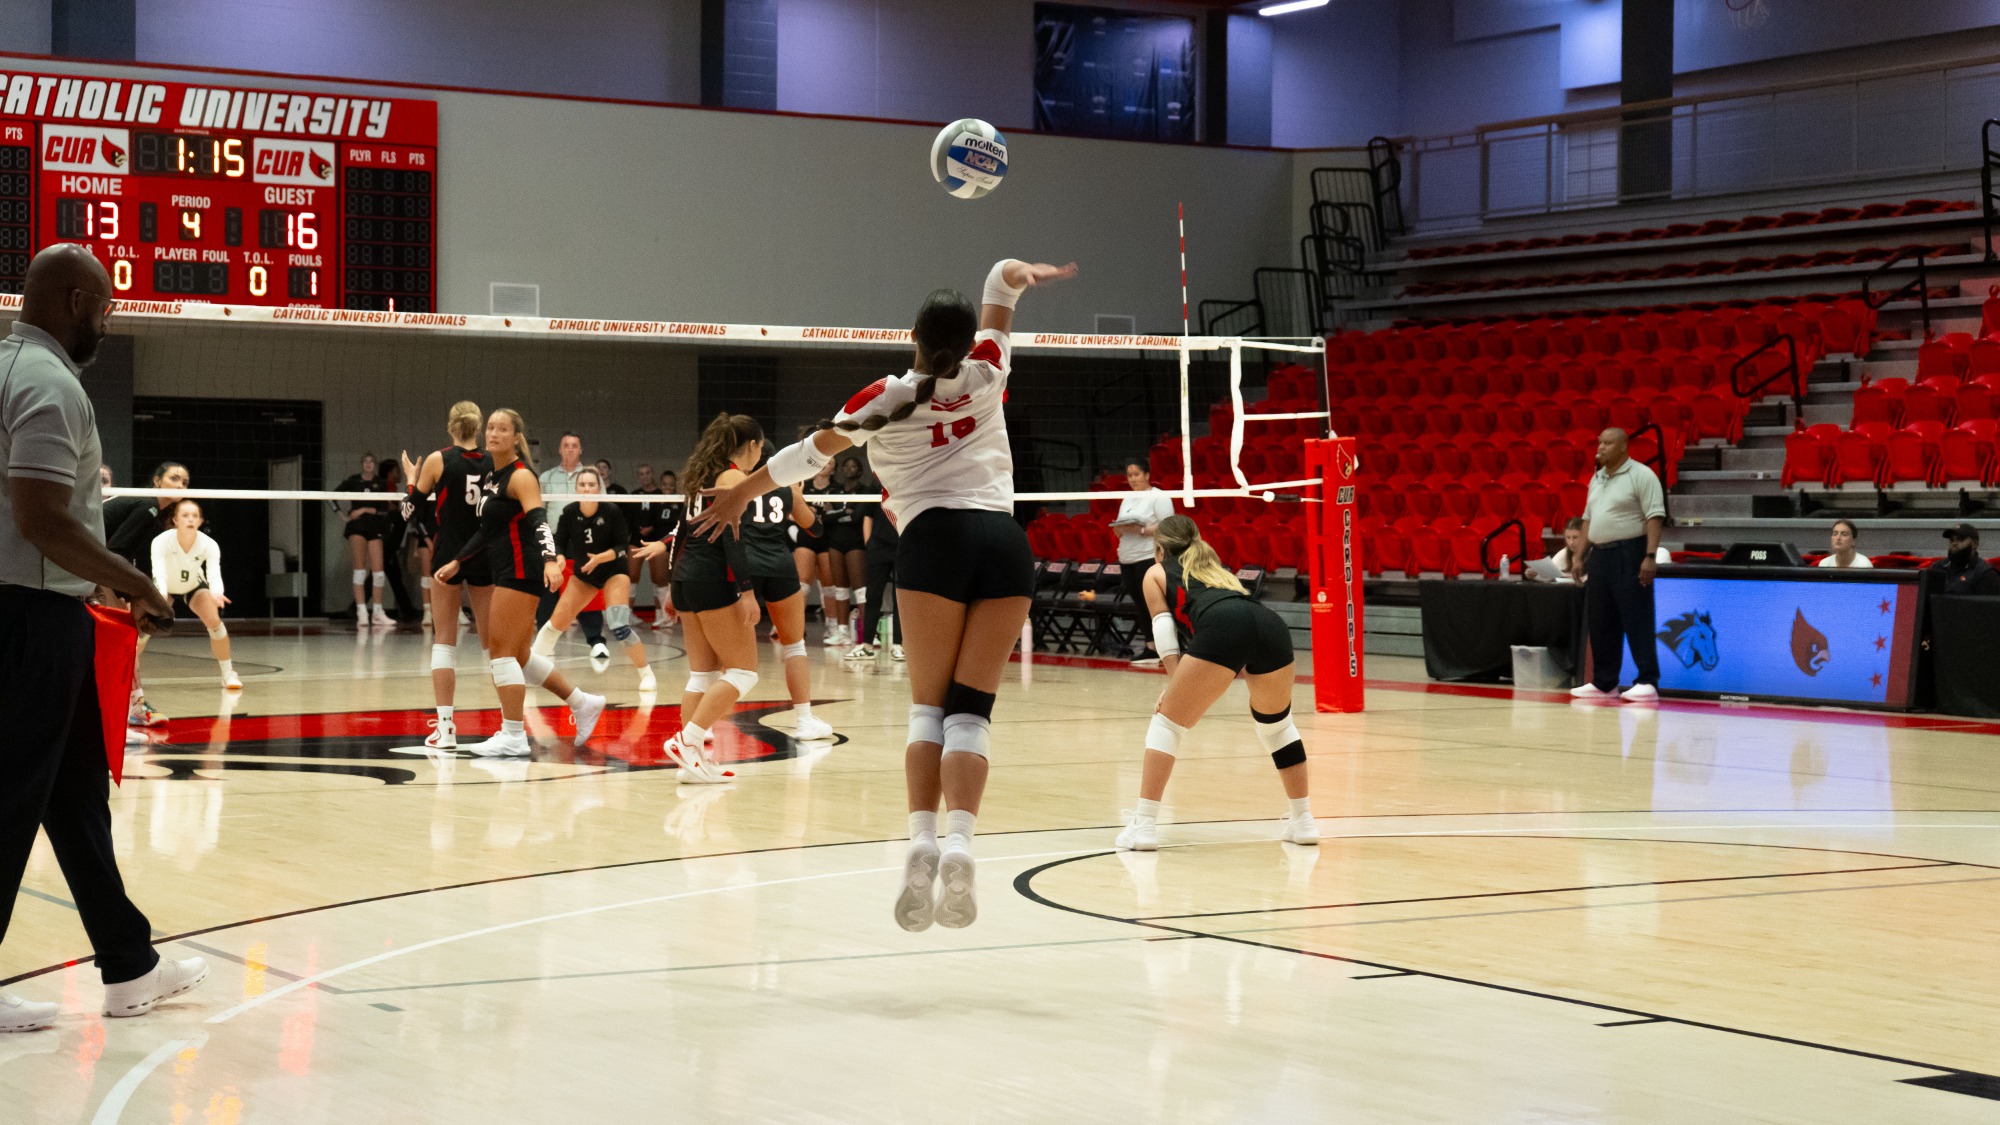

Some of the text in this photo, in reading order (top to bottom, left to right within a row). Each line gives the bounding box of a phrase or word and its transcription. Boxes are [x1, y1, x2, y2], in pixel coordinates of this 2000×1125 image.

[178, 87, 392, 139] UNIVERSITY
[5, 126, 23, 141] PTS
[44, 135, 97, 164] CUA
[178, 138, 245, 177] 1:15
[349, 149, 425, 165] PLYR FLS PTS
[965, 137, 1004, 159] molten
[255, 148, 305, 177] CUA
[964, 150, 999, 173] NCAA
[61, 175, 123, 196] HOME
[171, 195, 211, 209] PERIOD
[264, 186, 315, 206] GUEST
[87, 201, 119, 240] 13
[183, 211, 200, 238] 4
[287, 212, 318, 250] 16
[107, 245, 140, 259] T.O.L.
[154, 247, 230, 263] PLAYER FOUL
[243, 251, 274, 265] T.O.L.
[288, 254, 322, 267] FOULS
[114, 260, 132, 291] 0
[249, 265, 267, 297] 0
[311, 271, 317, 296] 1
[114, 301, 182, 315] CARDINALS
[272, 309, 467, 327] CATHOLIC UNIVERSITY CARDINALS
[549, 319, 727, 336] CATHOLIC UNIVERSITY CARDINALS
[802, 328, 909, 341] CATHOLIC UNIVERSITY
[1034, 334, 1078, 345] CATHOLIC
[1080, 335, 1133, 346] UNIVERSITY
[465, 474, 481, 506] 5
[1336, 486, 1355, 505] CUA
[753, 495, 784, 523] 13
[584, 528, 593, 544] 3
[1750, 550, 1767, 561] POSS
[180, 569, 190, 583] 9
